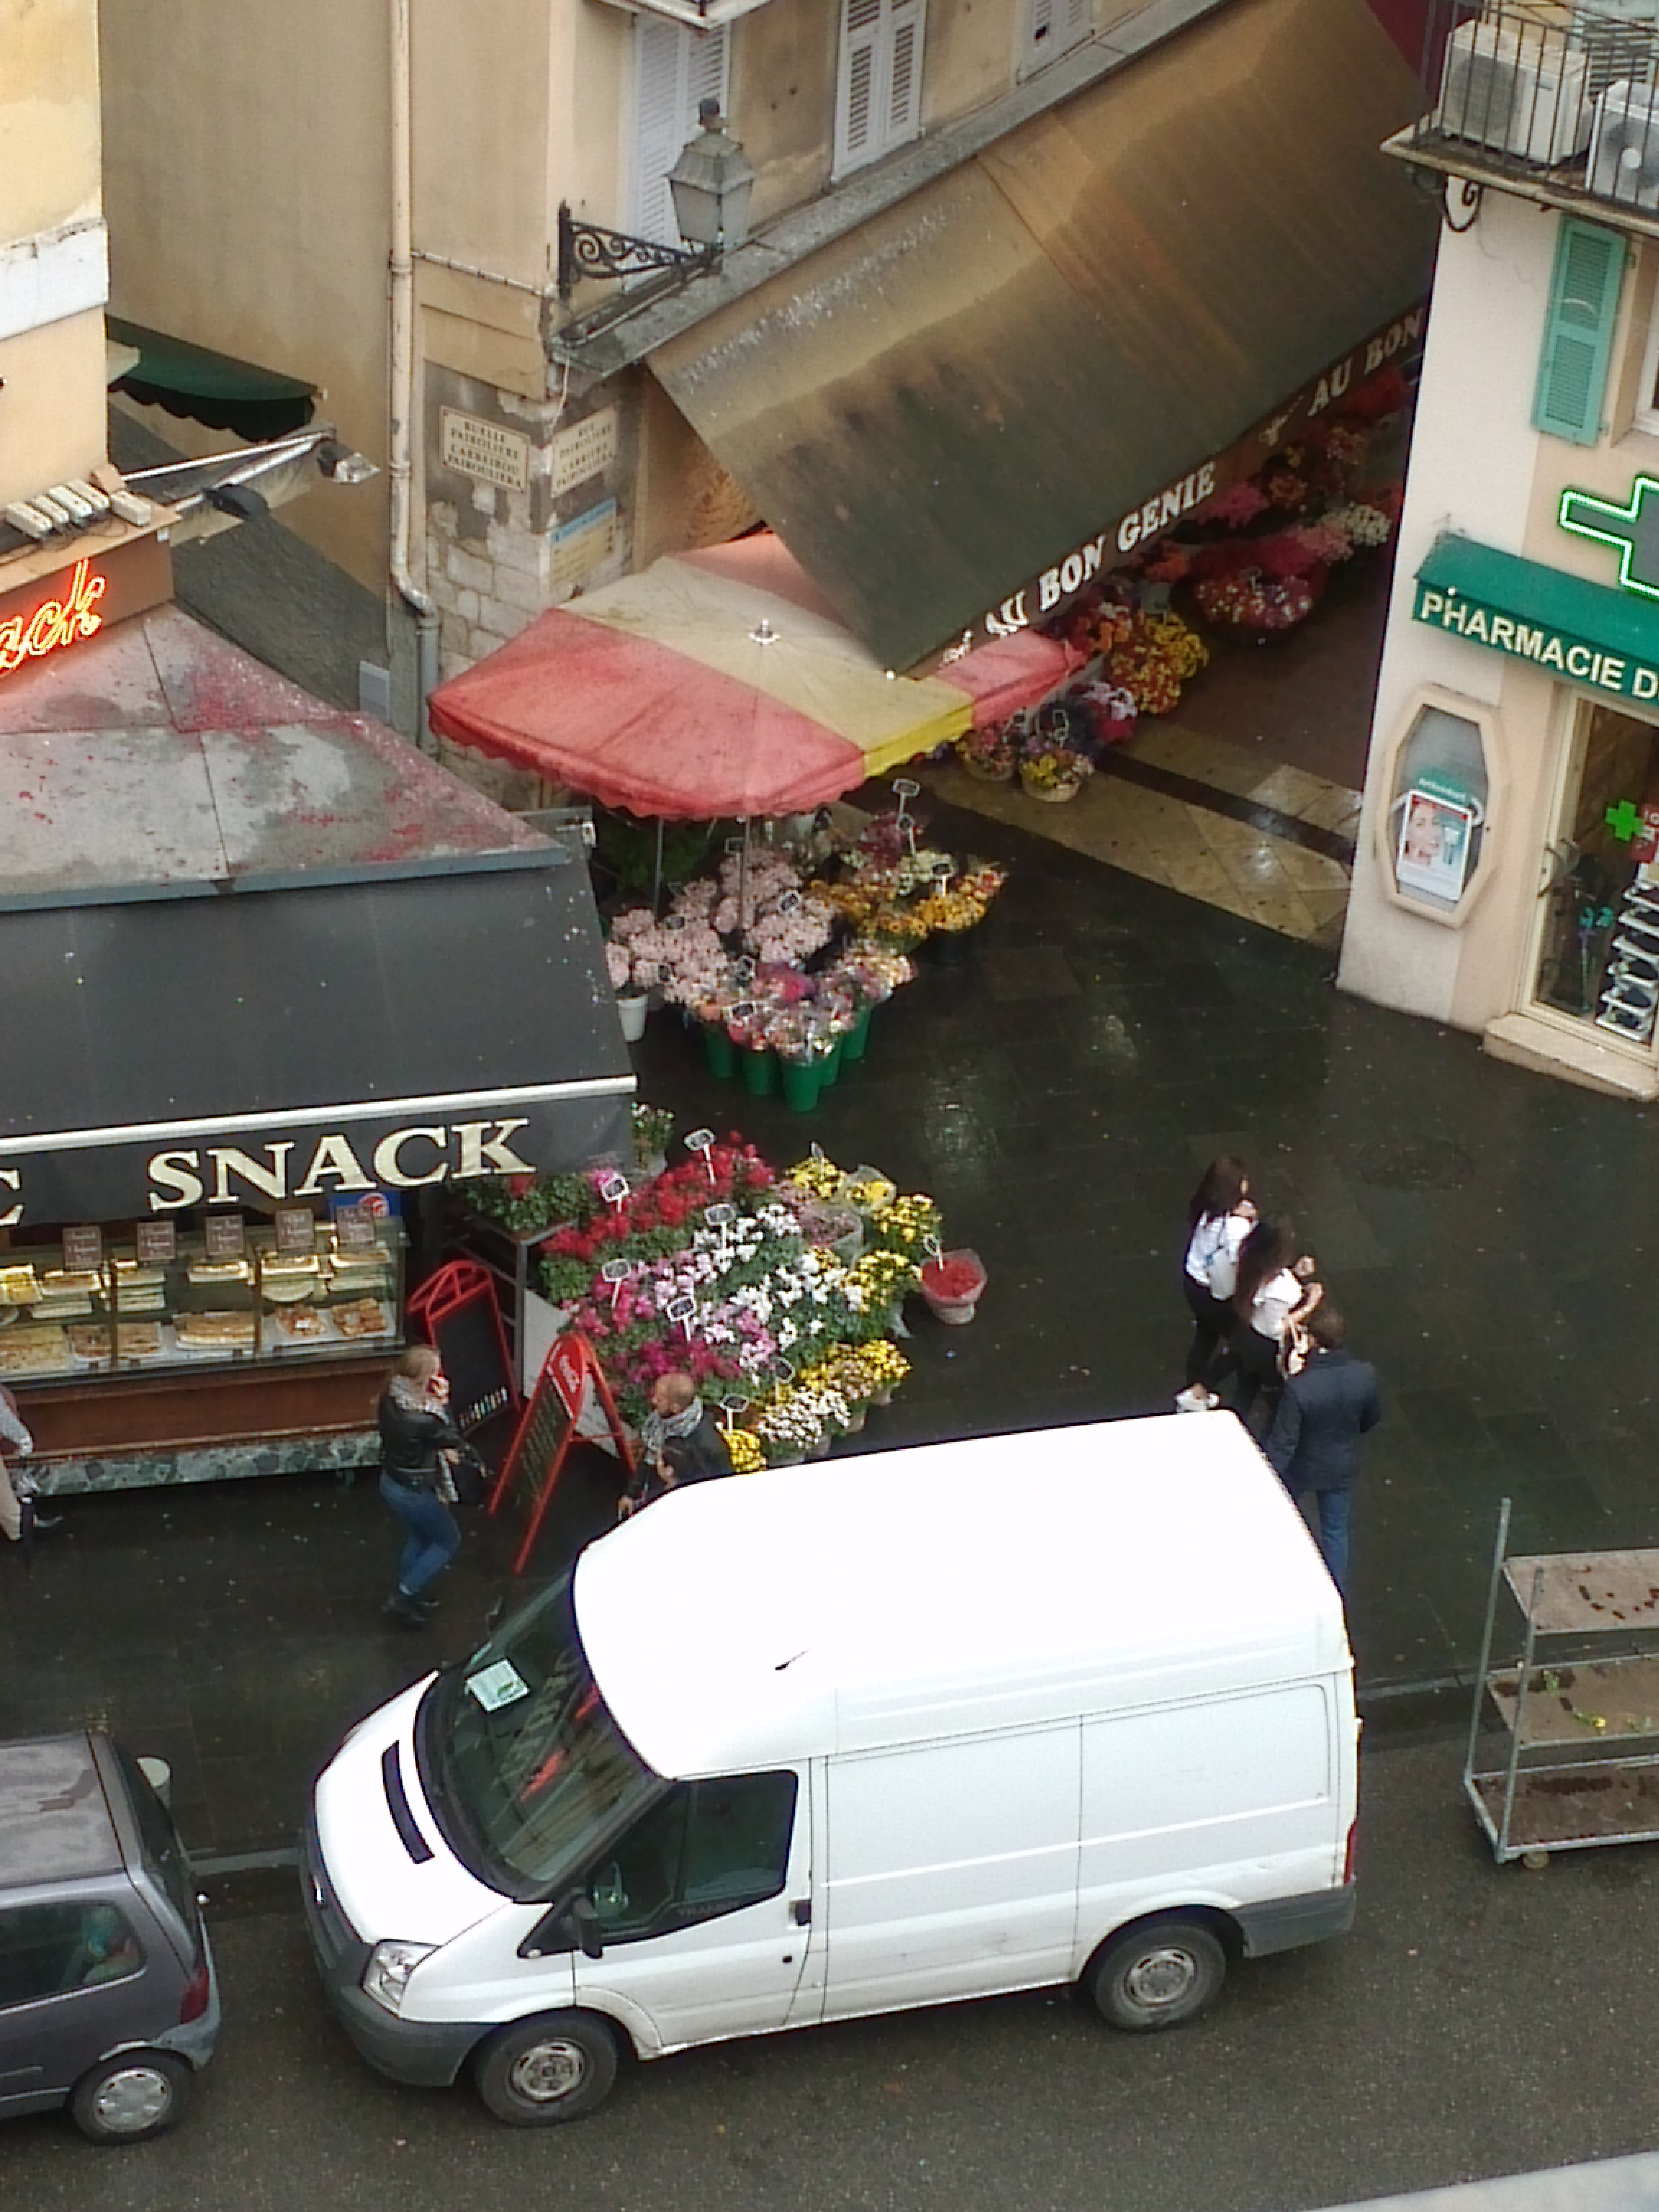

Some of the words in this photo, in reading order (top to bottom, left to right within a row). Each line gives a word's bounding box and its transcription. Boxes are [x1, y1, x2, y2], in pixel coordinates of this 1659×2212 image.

[1307, 357, 1354, 418] AU
[1363, 307, 1424, 375] BON
[985, 589, 1029, 637] AU
[1038, 533, 1106, 613] BON
[1117, 460, 1215, 552] GENIE
[1419, 590, 1626, 692] PHARMACIE
[1633, 667, 1659, 699] D
[146, 1117, 538, 1214] SNACK
